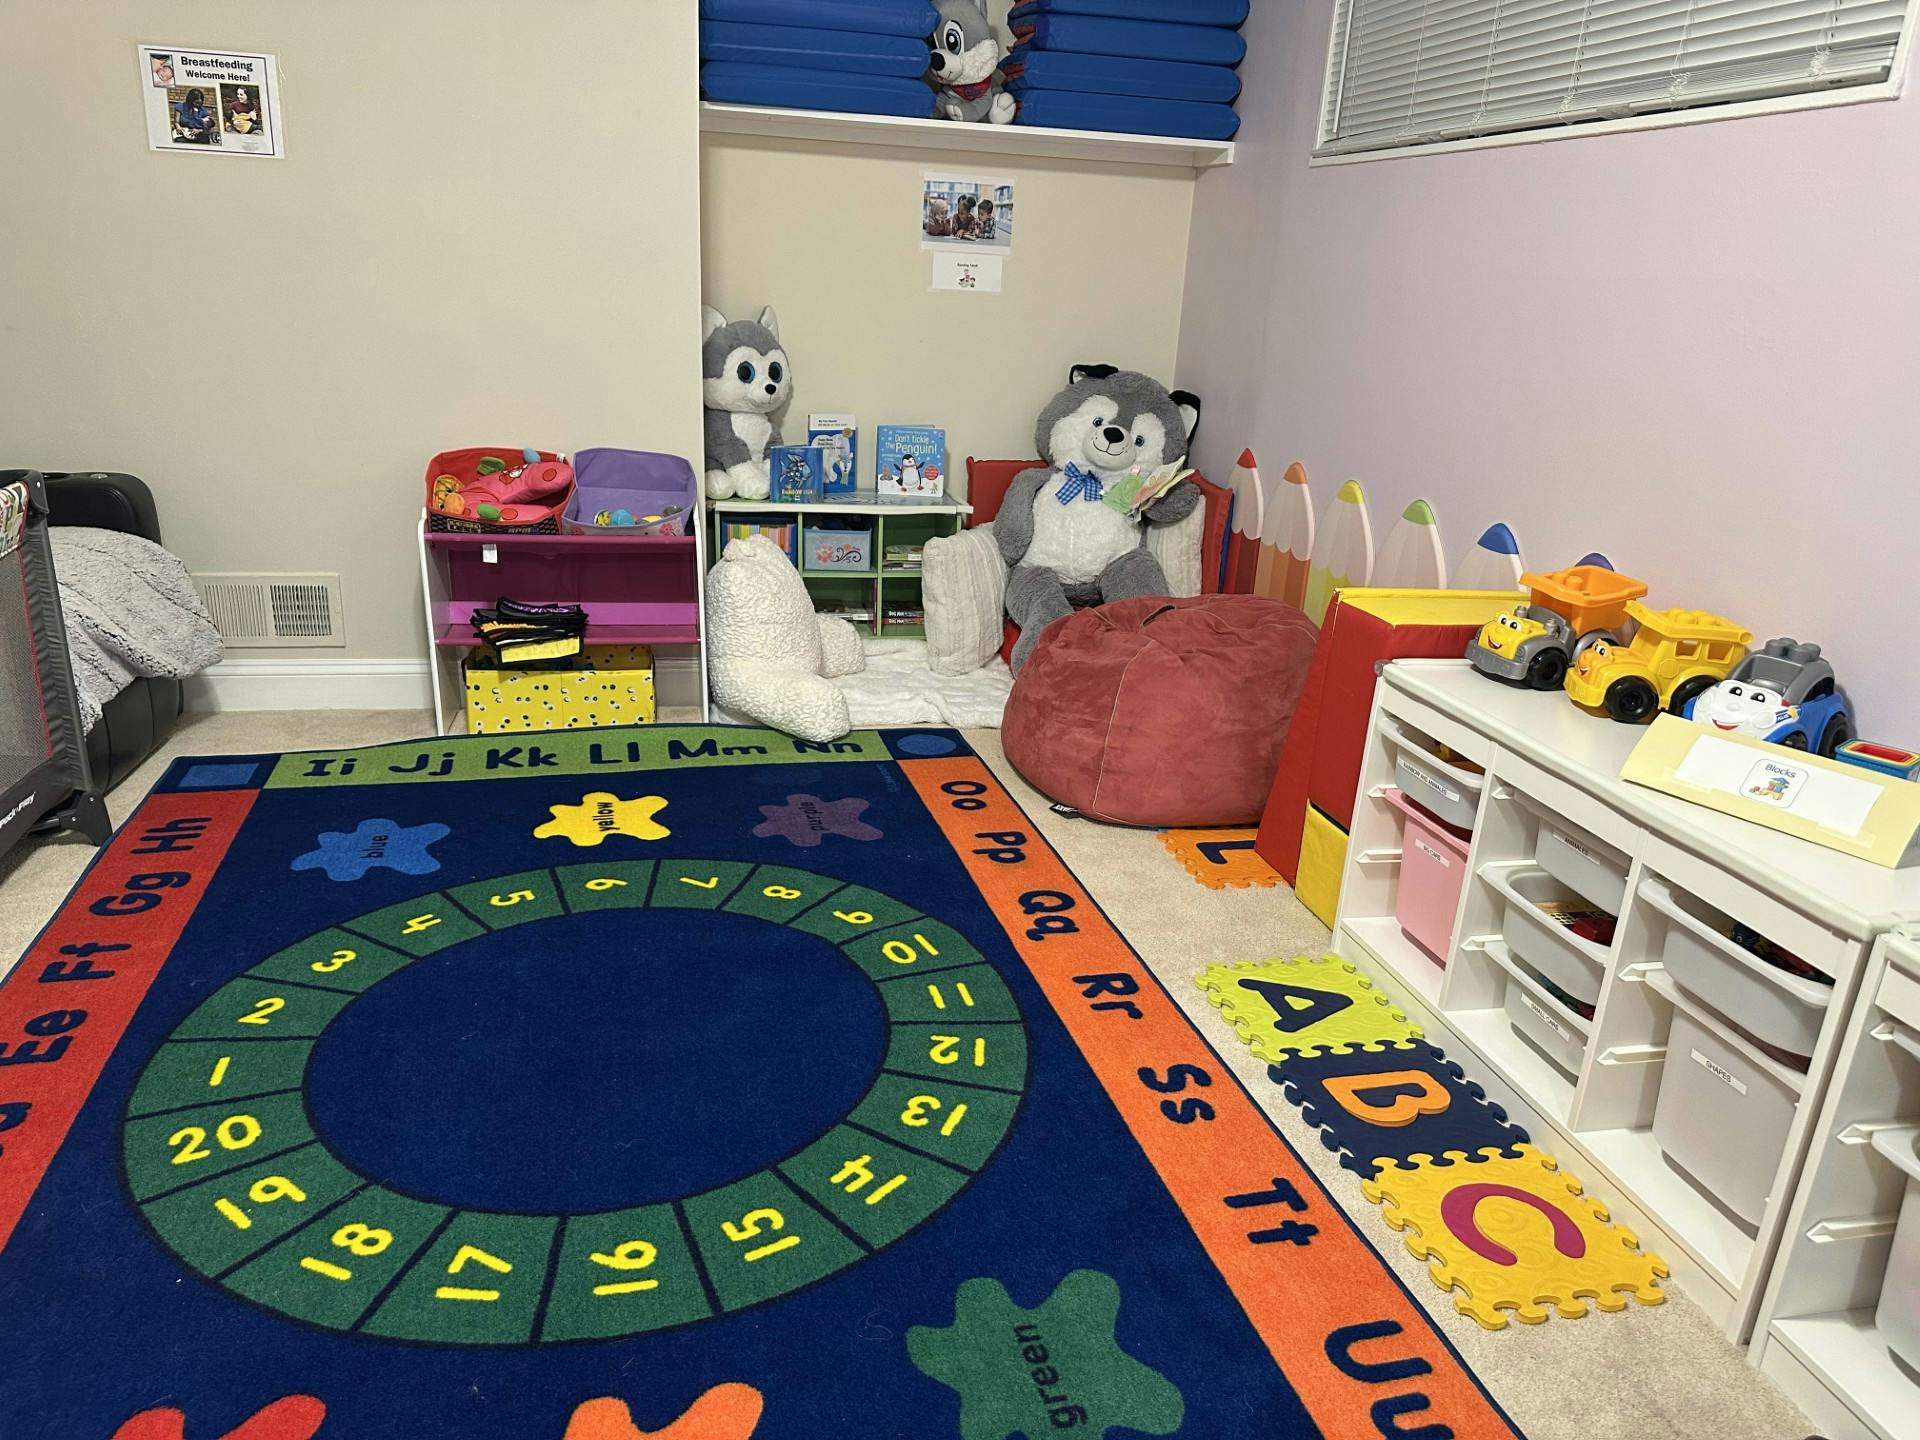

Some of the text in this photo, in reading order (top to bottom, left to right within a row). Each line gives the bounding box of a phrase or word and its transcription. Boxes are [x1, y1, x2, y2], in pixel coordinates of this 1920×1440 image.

[180, 56, 253, 72] Breastfeeding
[185, 70, 251, 82] Welcome Here!
[885, 441, 938, 456] the Penguin!
[895, 433, 911, 442] Don't
[302, 738, 864, 777] Ii Jj Kk Ll Mm Nn
[1764, 763, 1797, 779] Blocks
[592, 801, 619, 833] yellow
[798, 801, 831, 832] purple
[360, 834, 389, 860] blue
[488, 889, 537, 907] 5
[584, 877, 628, 891] 6
[680, 876, 720, 890] 7
[762, 885, 802, 900] 8
[403, 913, 441, 934] 4
[832, 909, 874, 925] 9
[0, 817, 213, 1067] Ee Ff Gg Hh
[880, 933, 940, 965] 10
[310, 949, 357, 974] 3
[238, 997, 286, 1025] 2
[927, 981, 975, 1010] 11
[928, 1034, 986, 1068] 12
[208, 1056, 230, 1087] 1
[1706, 1060, 1731, 1083] SHAPES
[900, 1094, 968, 1137] 13
[940, 780, 1456, 1440] Oo Pp Qq Rr Ss Tt Uu
[1238, 978, 1586, 1266] A B C
[167, 1113, 262, 1166] 20
[830, 1153, 908, 1206] 14
[214, 1175, 307, 1230] 19
[720, 1207, 802, 1262] 15
[299, 1222, 394, 1282] 18
[436, 1244, 513, 1302] 17
[591, 1240, 659, 1297] 16
[1013, 1324, 1089, 1429] green
